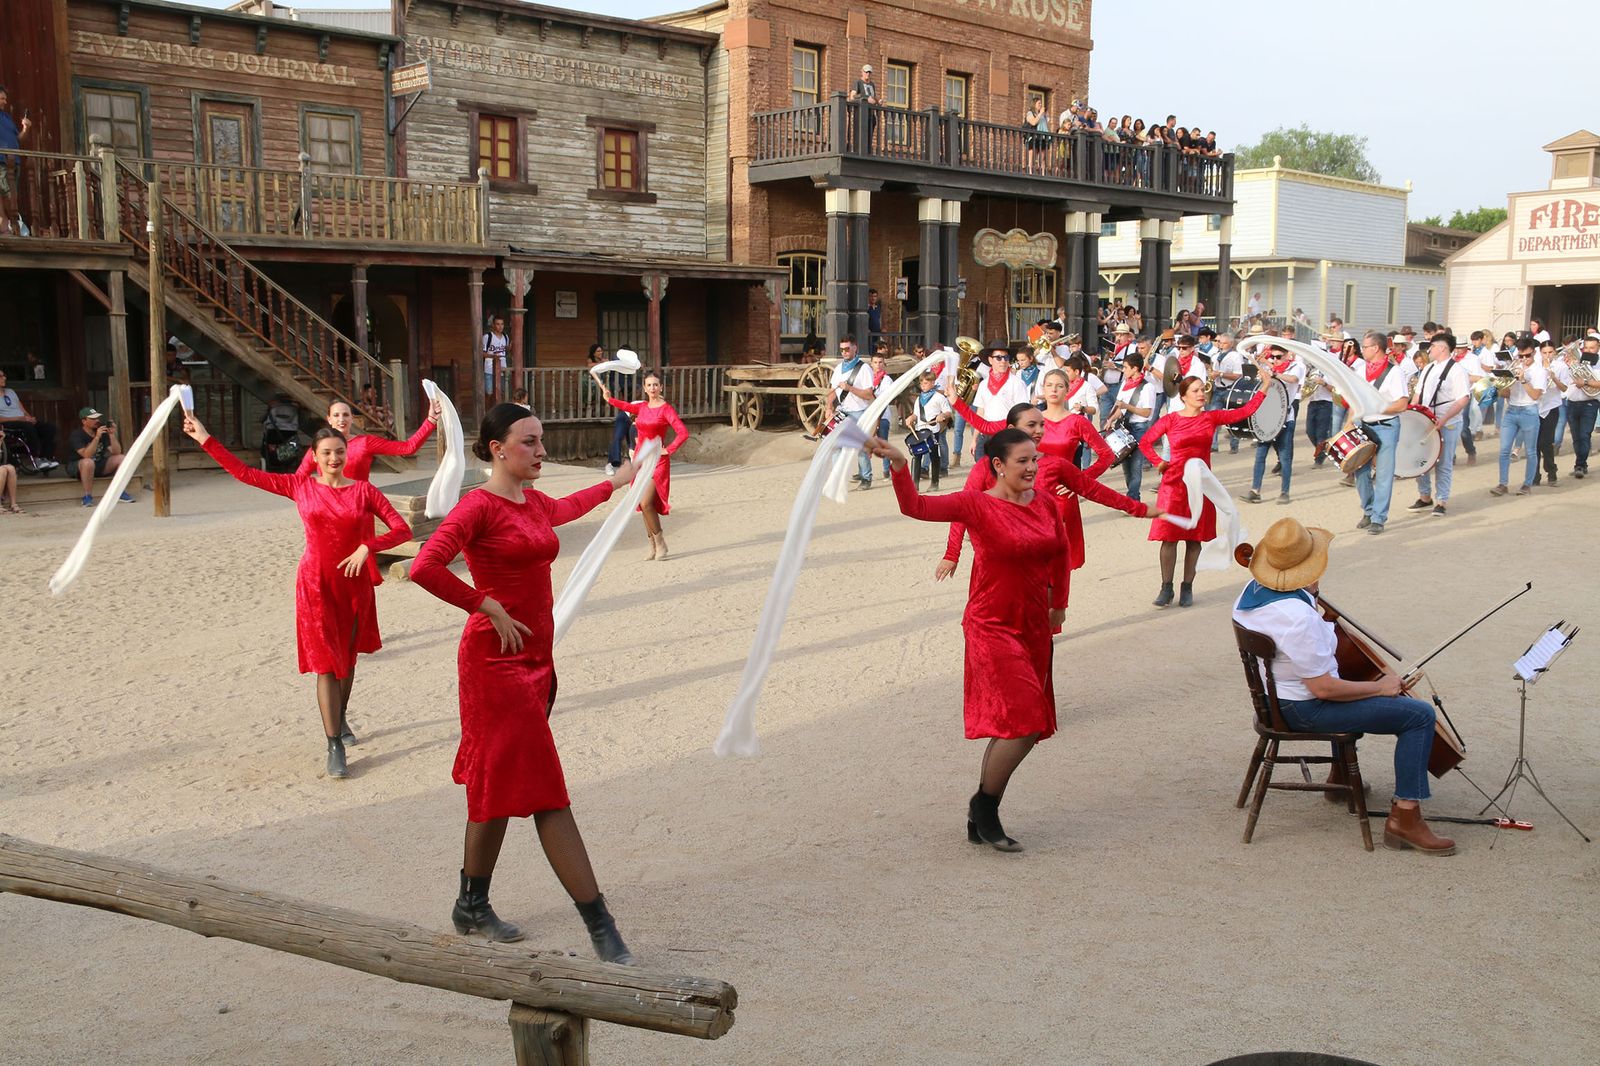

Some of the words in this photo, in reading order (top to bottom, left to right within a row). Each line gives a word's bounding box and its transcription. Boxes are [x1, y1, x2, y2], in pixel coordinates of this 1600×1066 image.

[74, 30, 215, 68] EVENING
[224, 51, 357, 86] JOURNAL
[416, 36, 545, 79] OVERLAND
[553, 57, 621, 89] STAGE
[628, 67, 690, 99] LINES
[1528, 199, 1600, 233] FIRE
[1519, 233, 1600, 252] DEPARTMEN
